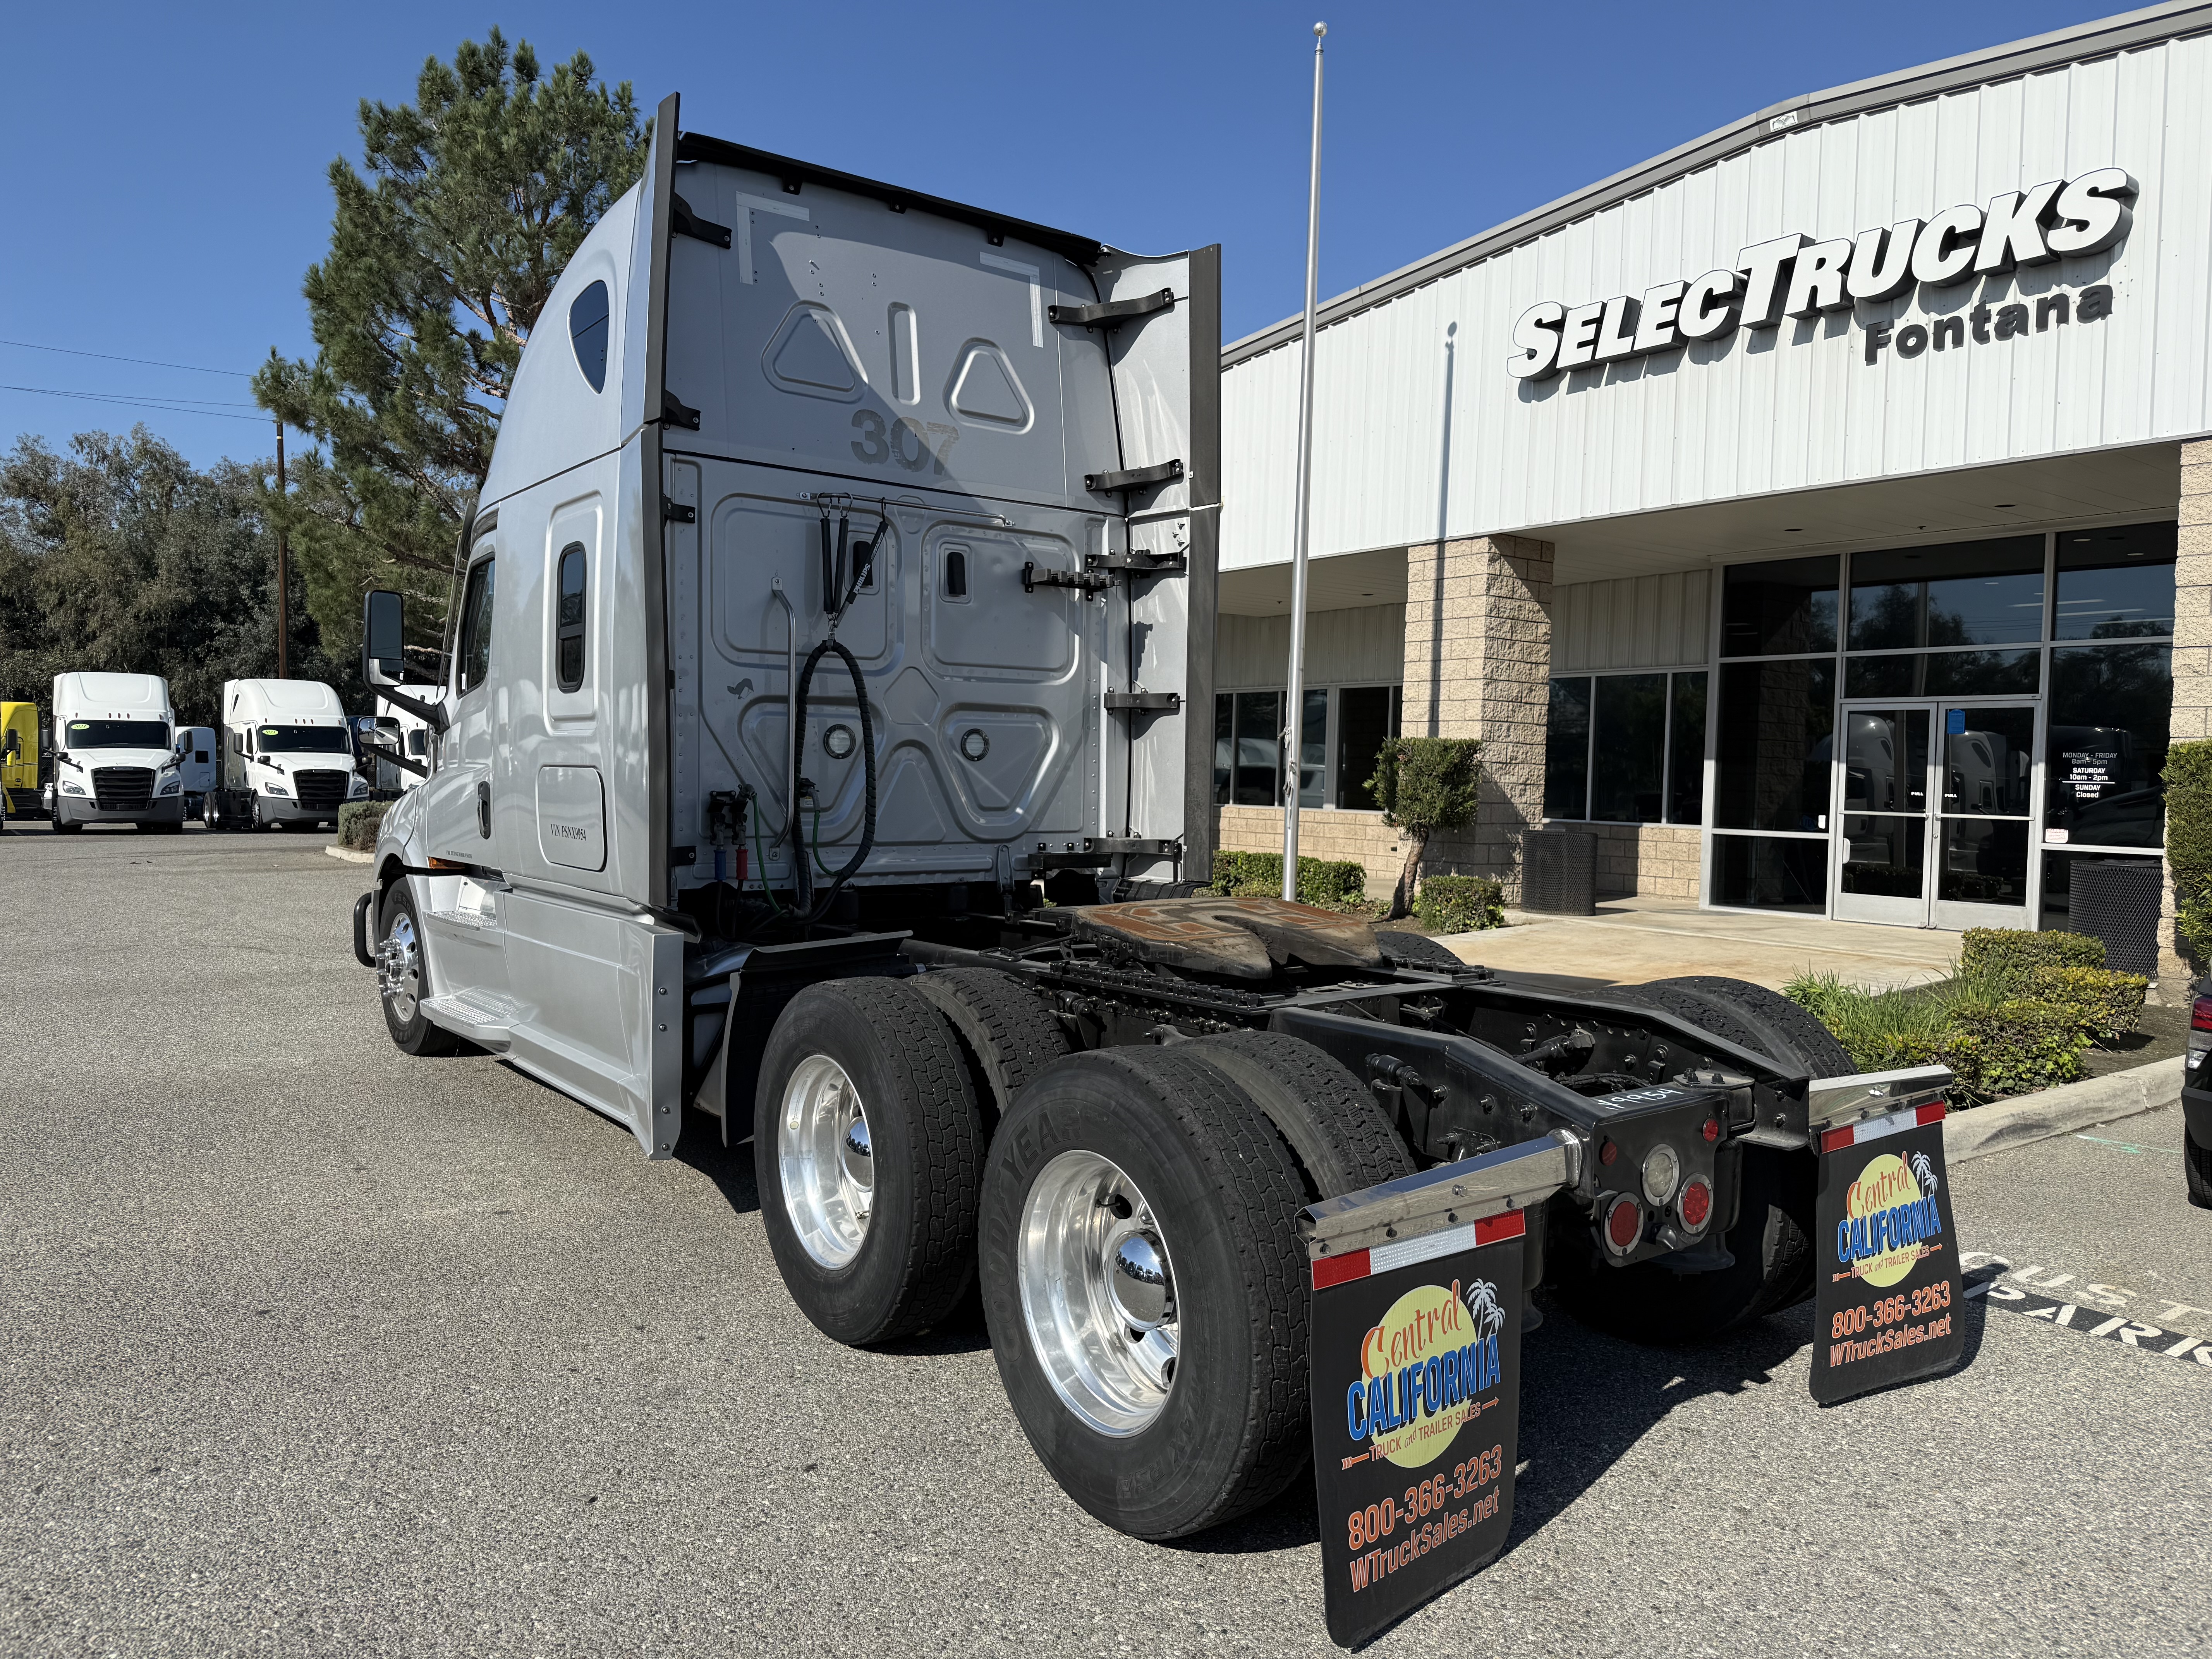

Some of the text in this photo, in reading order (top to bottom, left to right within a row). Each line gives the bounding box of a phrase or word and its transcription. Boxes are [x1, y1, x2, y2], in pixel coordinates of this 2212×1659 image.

[1508, 167, 2138, 382] SELECTRUCKS
[1864, 283, 2115, 365] Fontana
[851, 409, 960, 476] 307
[853, 563, 871, 594] PHILLIPS
[550, 824, 586, 841] VIN PSNX9954
[1846, 1151, 1911, 1220] Central
[1838, 1194, 1942, 1262] CALIFORNIA
[1851, 1245, 1930, 1278] TRUCK and TRAILER SALES
[1361, 1279, 1462, 1380] Central
[1830, 1312, 1951, 1367] WTruckSales.net
[1832, 1280, 1951, 1339] 800-366-3263
[1347, 1333, 1501, 1441] CALIFORNIA
[1369, 1402, 1481, 1461] TRUCK and TRAILER SALES
[1348, 1444, 1502, 1551] 800-366-3263
[1350, 1485, 1500, 1593] WTruckSales.net
